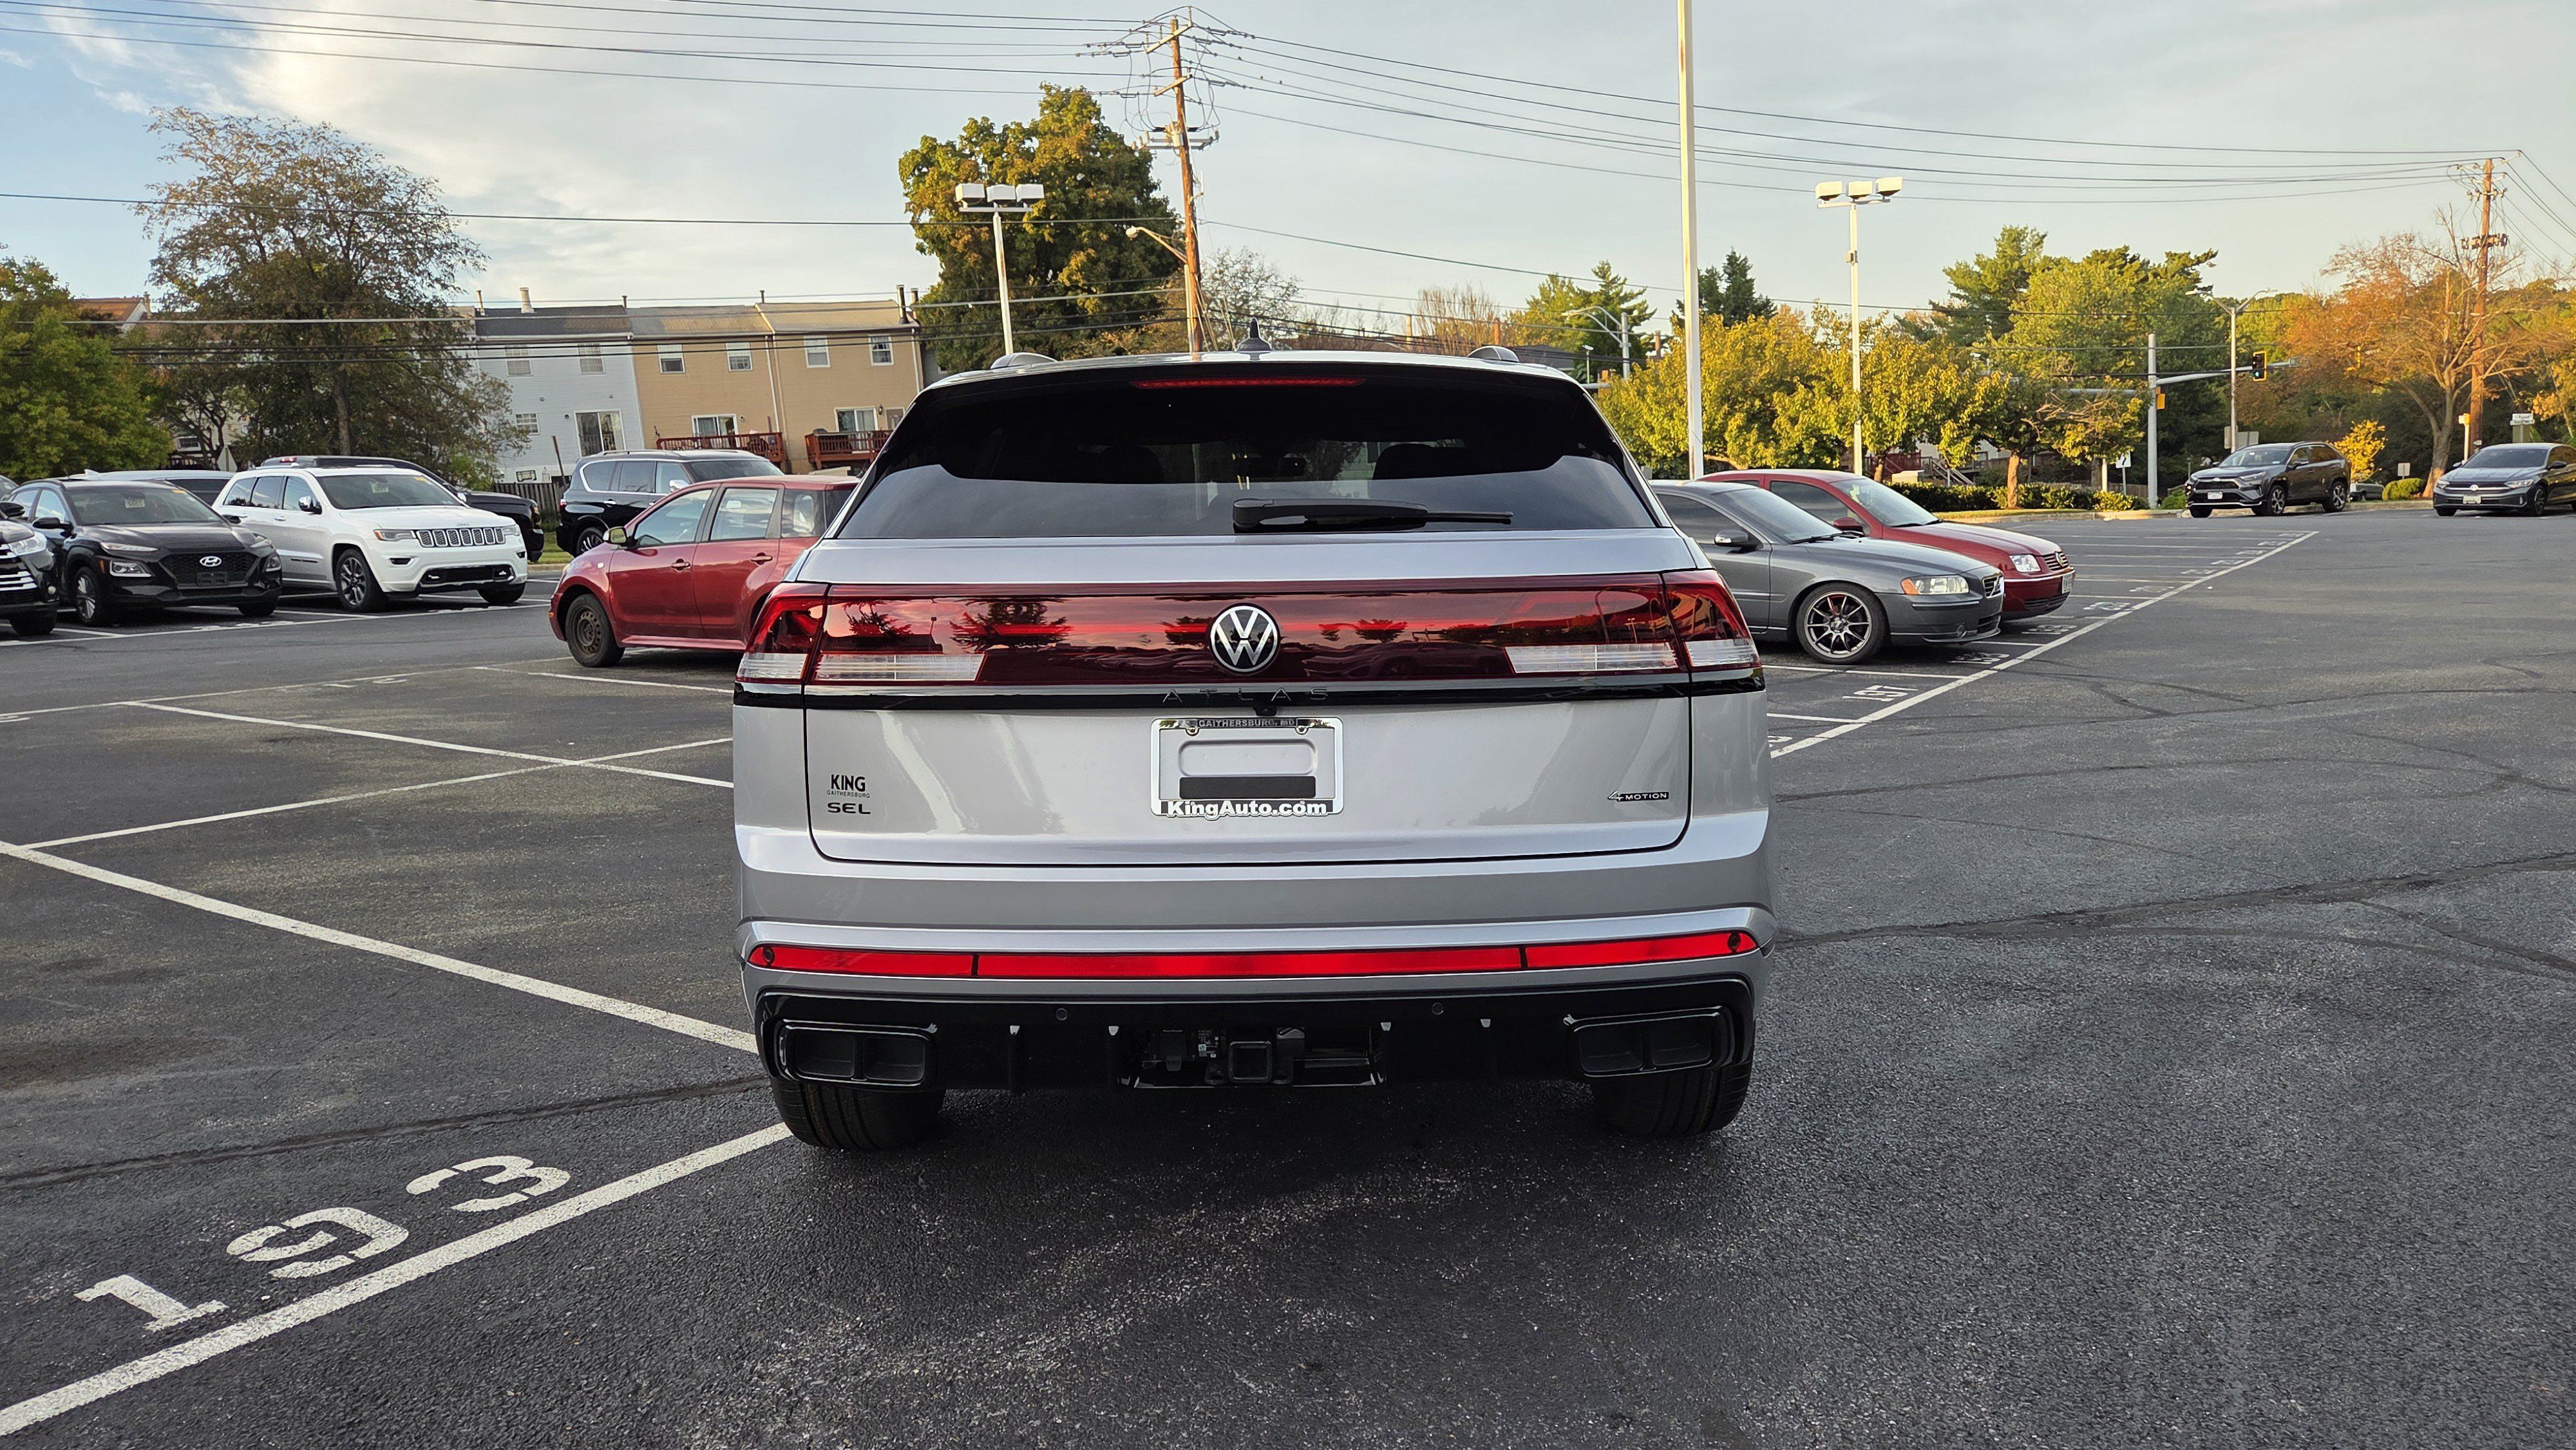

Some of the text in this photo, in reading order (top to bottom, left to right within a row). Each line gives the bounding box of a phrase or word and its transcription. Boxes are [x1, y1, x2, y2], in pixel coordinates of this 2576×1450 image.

[1162, 686, 1329, 704] ATLAS
[831, 774, 866, 792] KING
[827, 790, 870, 798] GAITHERSBURG
[1607, 791, 1667, 801] 4MOTION
[827, 802, 871, 814] SEL
[1168, 800, 1327, 820] KingAuto.com
[73, 1155, 571, 1332] 193
